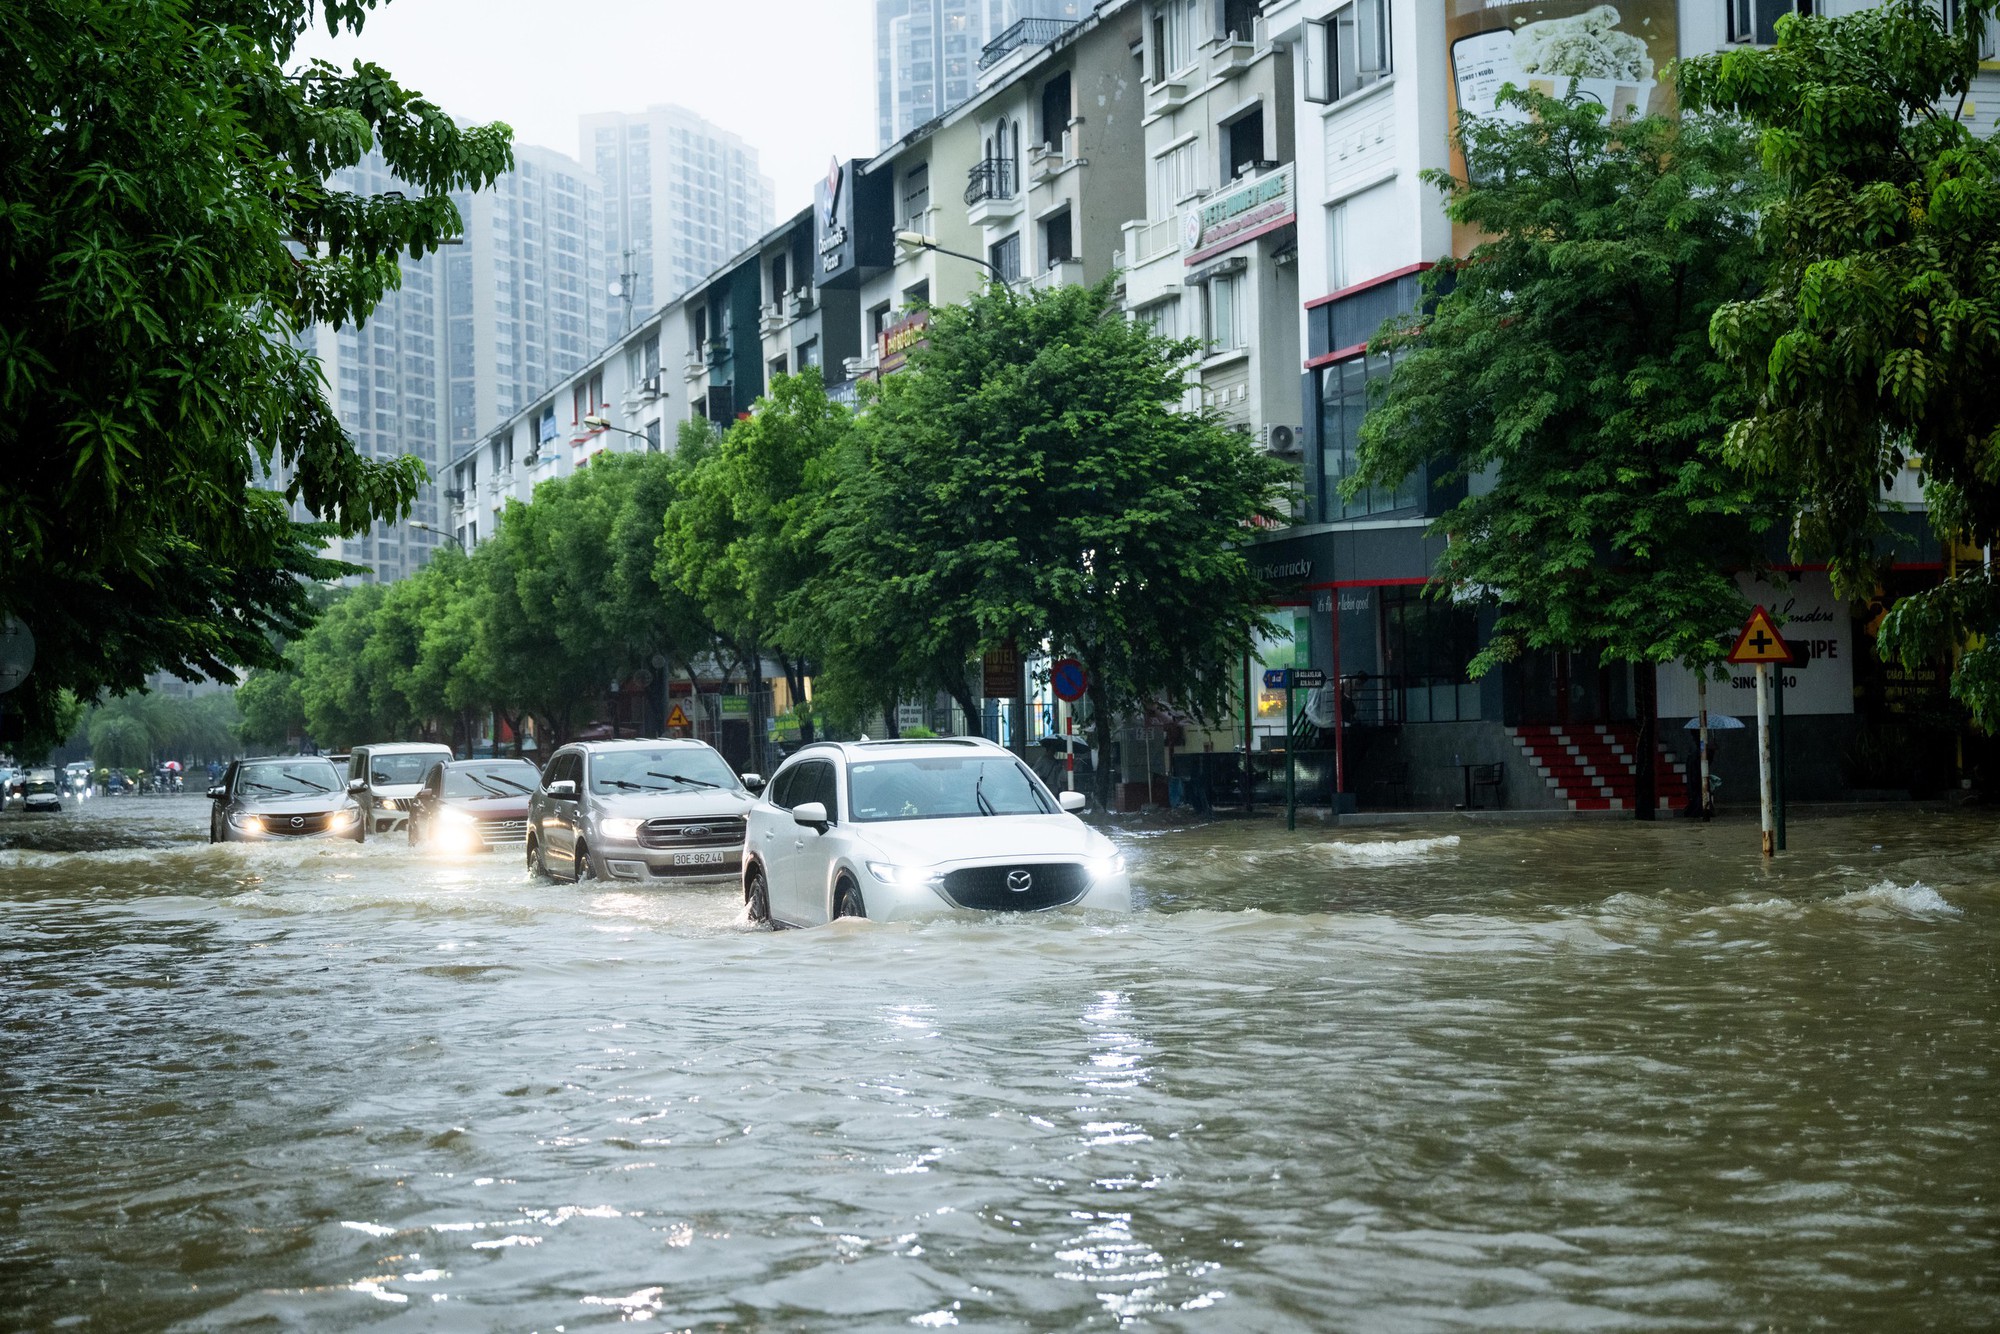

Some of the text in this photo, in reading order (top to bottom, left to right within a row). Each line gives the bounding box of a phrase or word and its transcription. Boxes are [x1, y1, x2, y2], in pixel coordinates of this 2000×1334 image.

[1459, 73, 1475, 83] COMBO
[818, 227, 844, 255] Domino's
[823, 254, 839, 272] Pizza
[1266, 558, 1313, 578] Kentucky
[985, 648, 1016, 664] HOTEL
[1732, 675, 1797, 689] SINC 140
[675, 852, 722, 865] 30E-962.44
